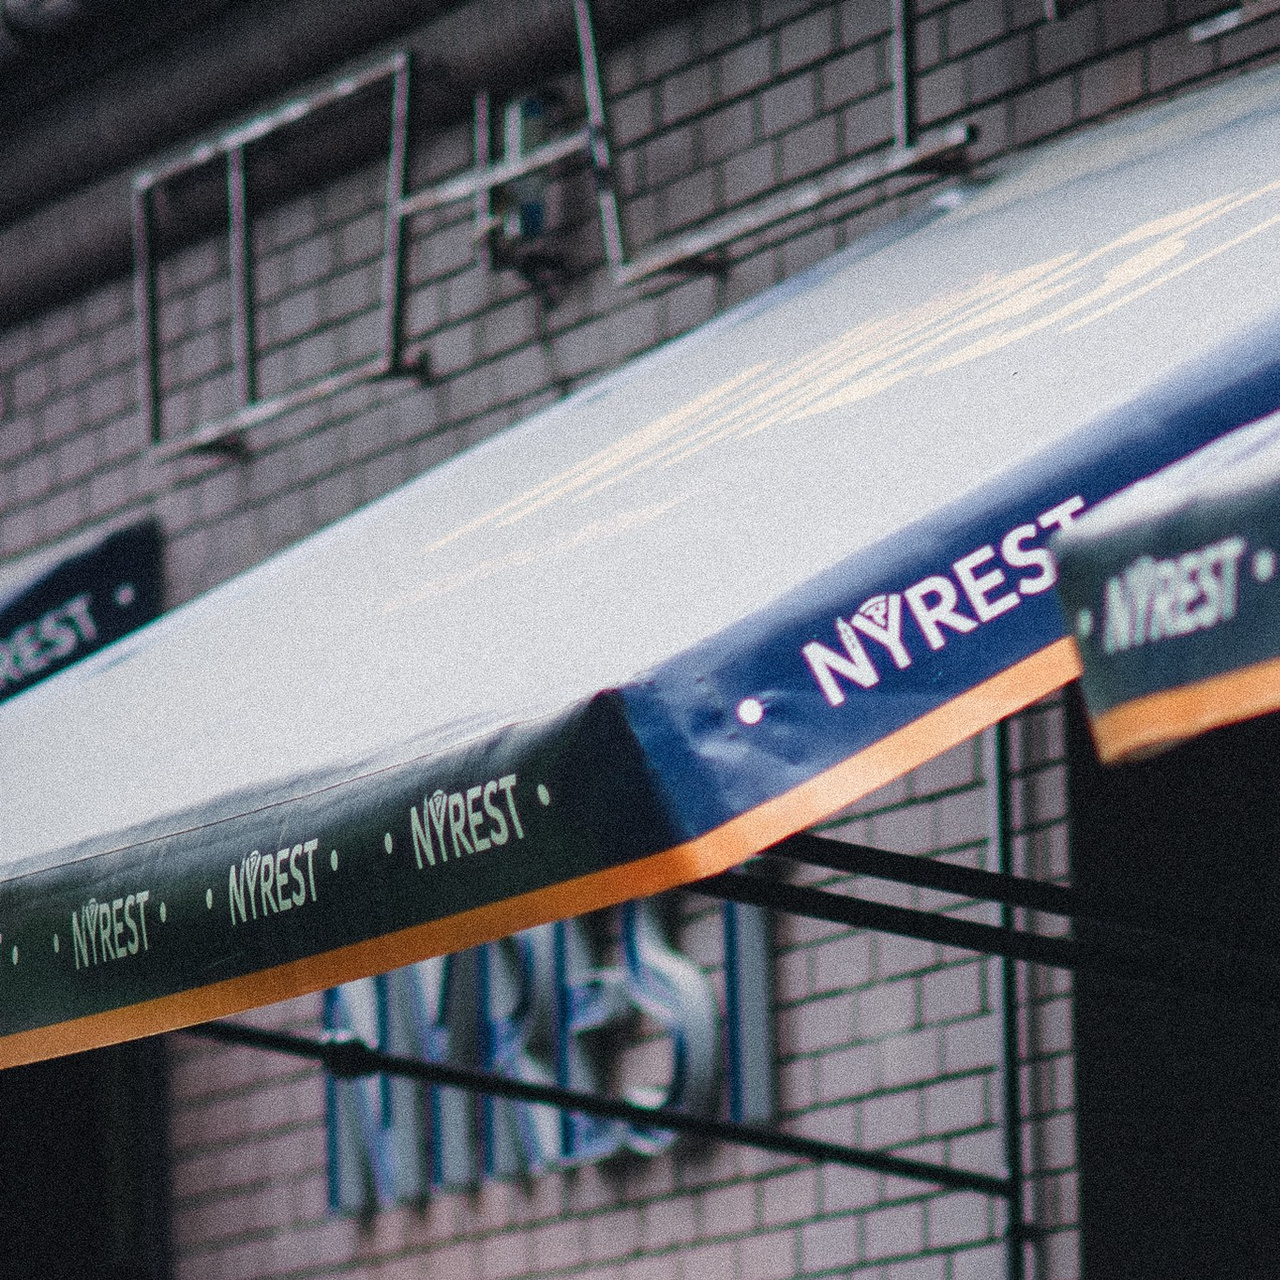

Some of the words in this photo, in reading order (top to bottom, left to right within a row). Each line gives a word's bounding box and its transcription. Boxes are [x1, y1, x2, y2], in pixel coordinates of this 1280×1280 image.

[802, 495, 1085, 707] NYREST
[1102, 537, 1246, 655] NYREST
[72, 890, 151, 970] NYREST
[228, 838, 320, 926] NYREST
[410, 774, 525, 870] NYREST
